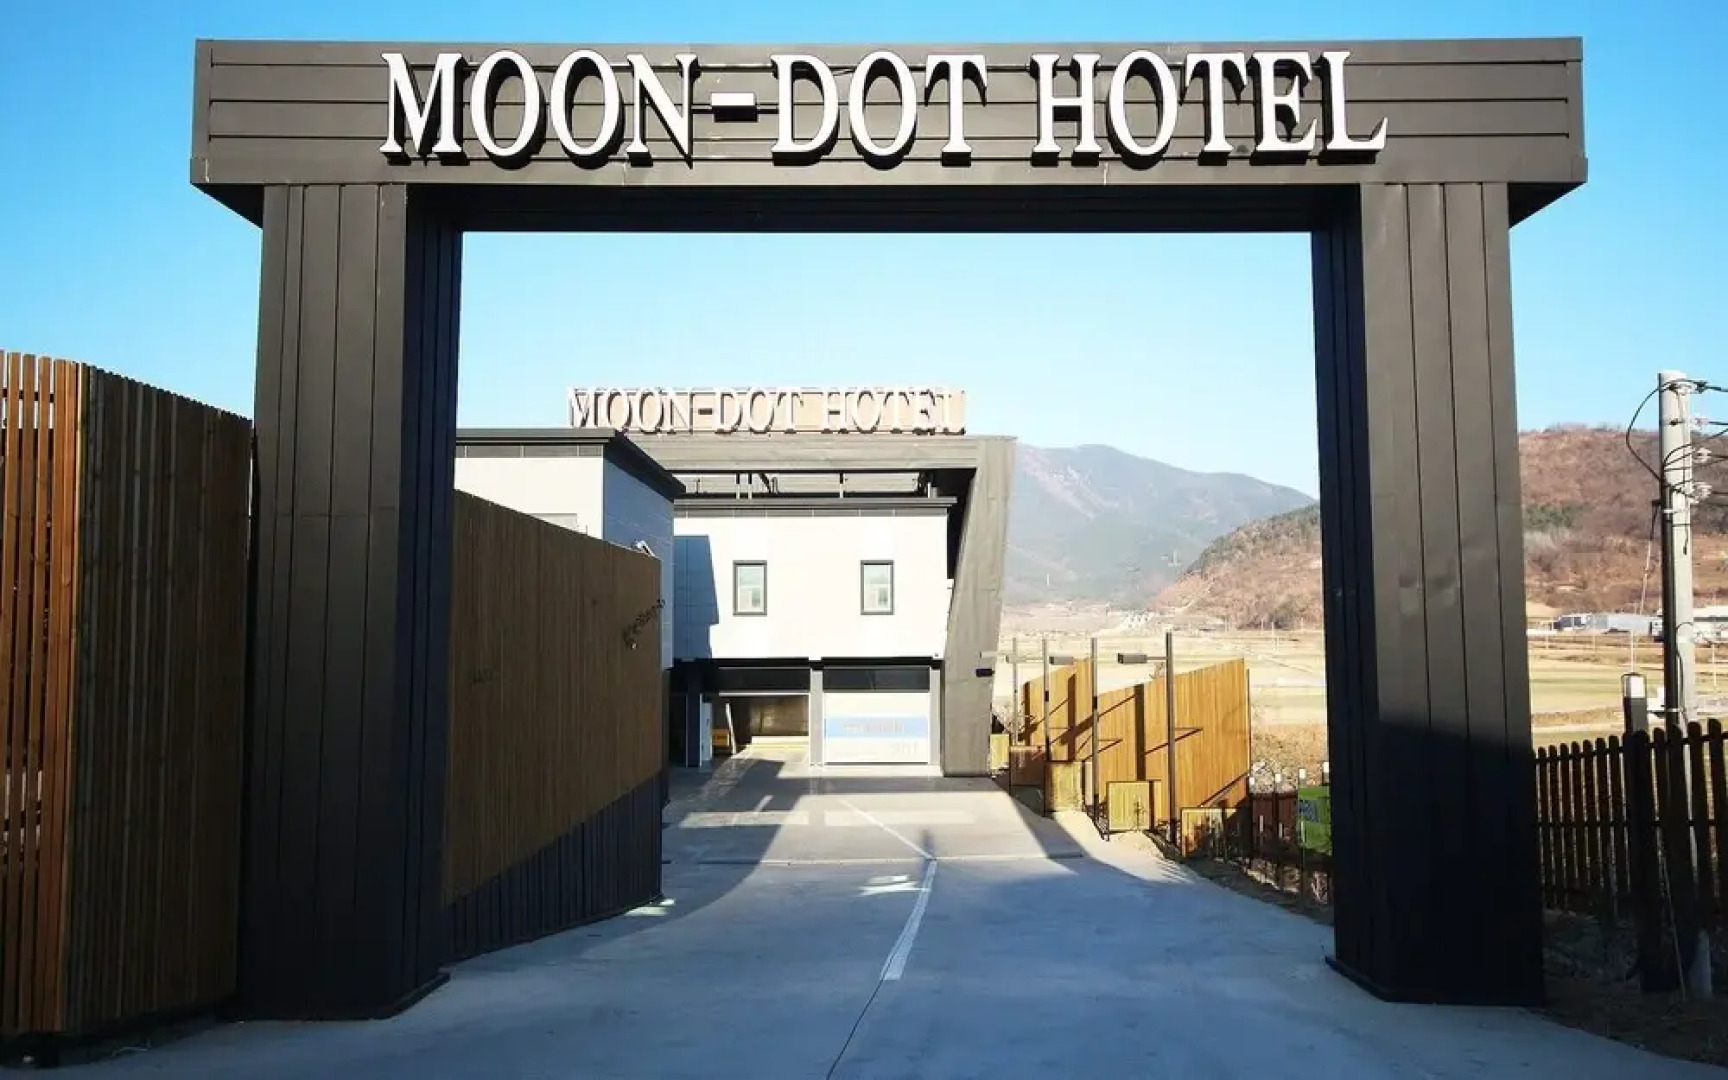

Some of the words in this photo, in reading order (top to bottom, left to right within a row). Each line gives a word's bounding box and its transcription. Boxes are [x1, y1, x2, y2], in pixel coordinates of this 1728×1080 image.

[380, 50, 986, 158] MOON-DOT
[1033, 50, 1388, 158] HOTEL
[568, 386, 803, 432] MOON-DOT
[822, 386, 968, 433] HOTEL
